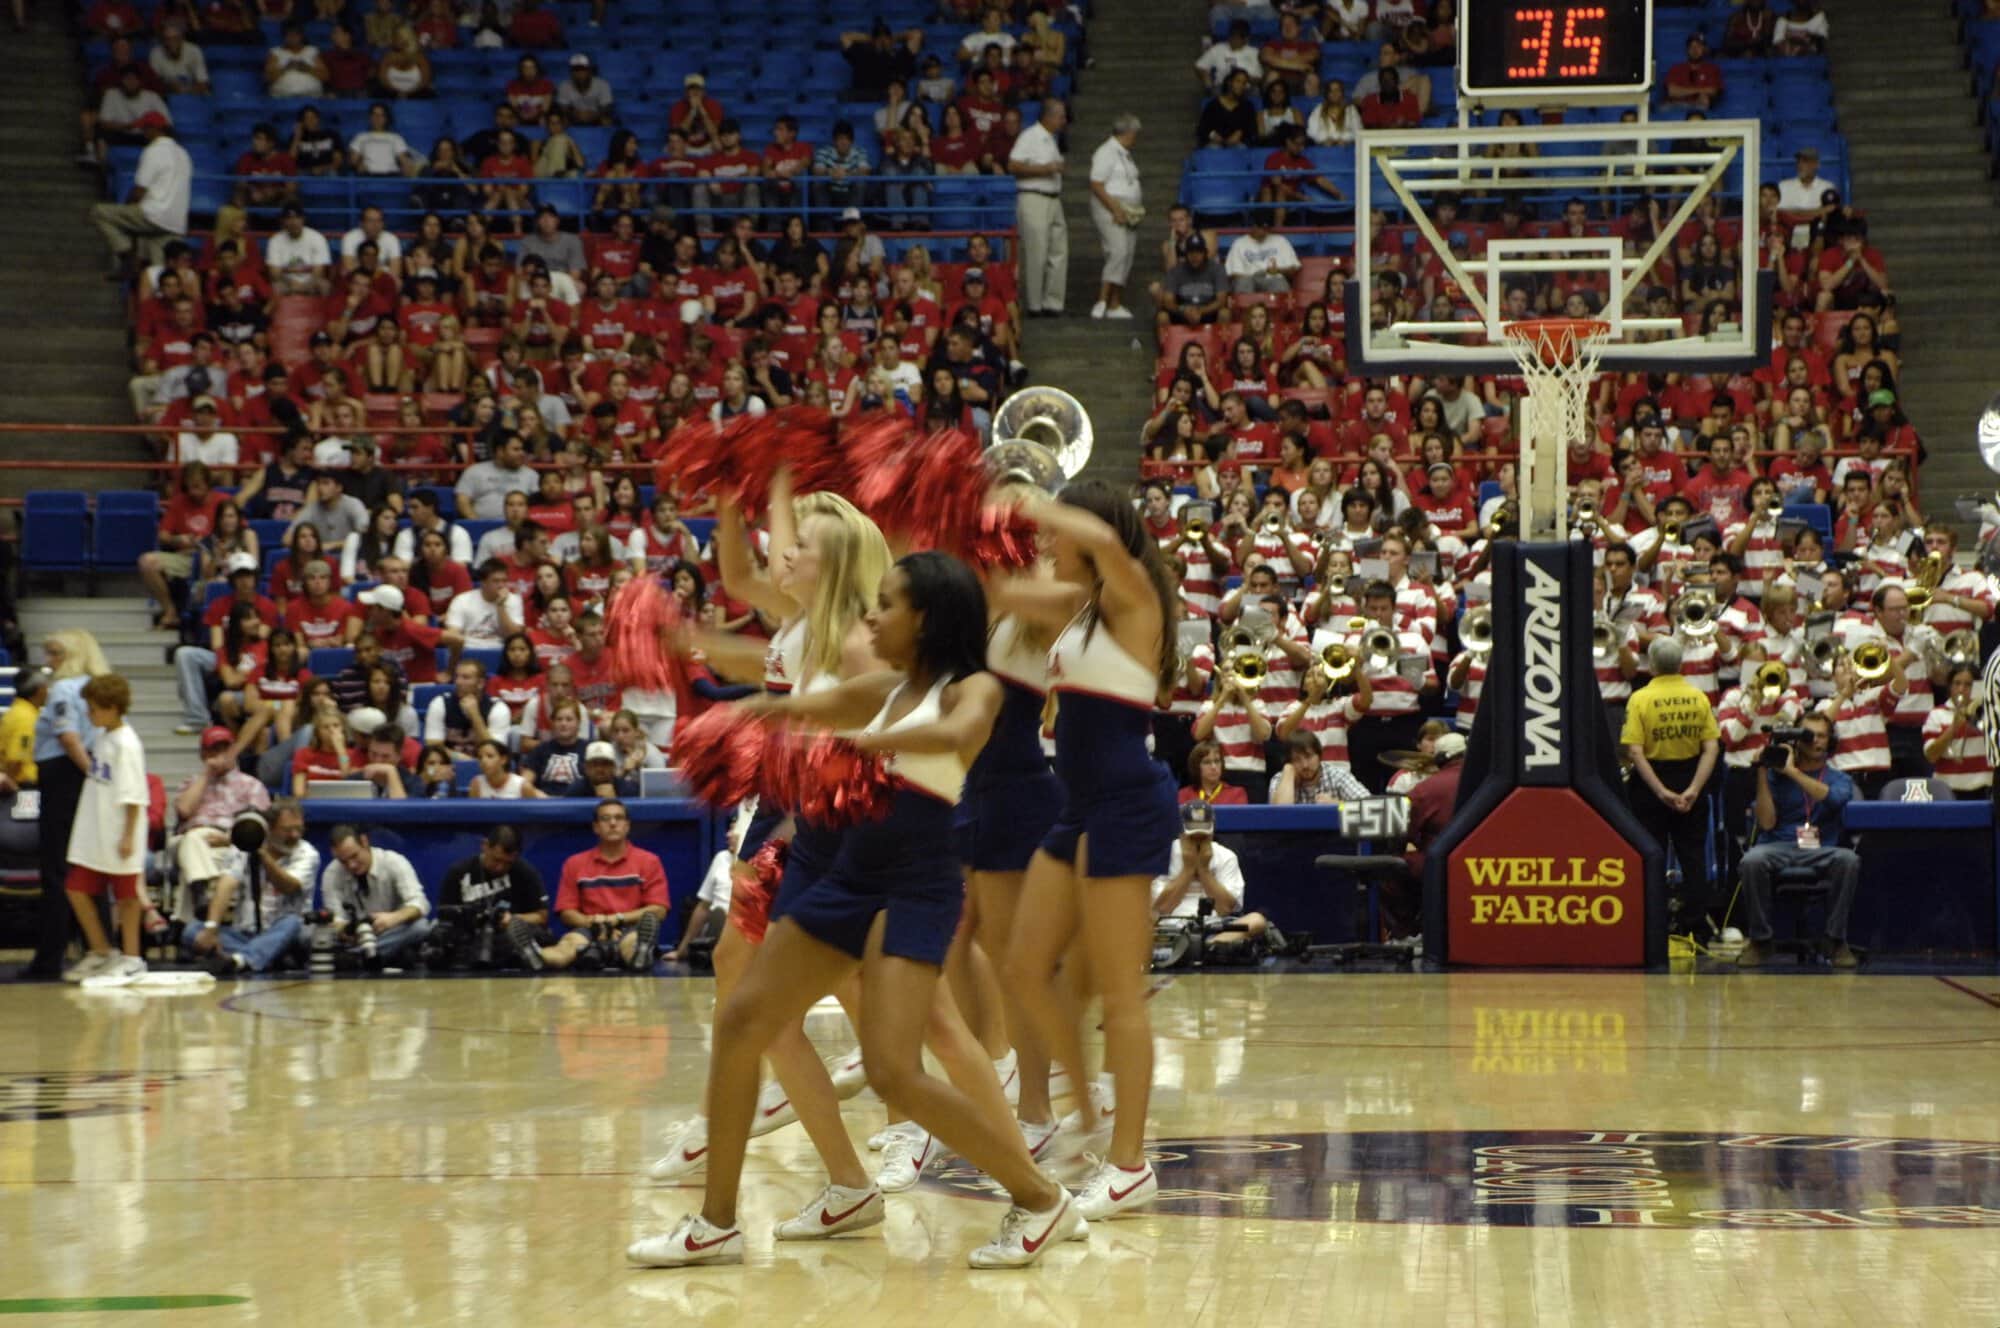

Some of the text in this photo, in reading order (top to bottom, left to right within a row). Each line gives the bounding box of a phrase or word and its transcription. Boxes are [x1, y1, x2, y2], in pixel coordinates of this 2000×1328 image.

[1507, 8, 1605, 78] 35
[1524, 558, 1562, 766] ARIZONA
[1653, 696, 1697, 708] EVENT
[1659, 711, 1698, 722] STAFF
[1341, 796, 1410, 836] FSN
[1465, 857, 1626, 888] WELLS
[1470, 895, 1623, 925] FARGO
